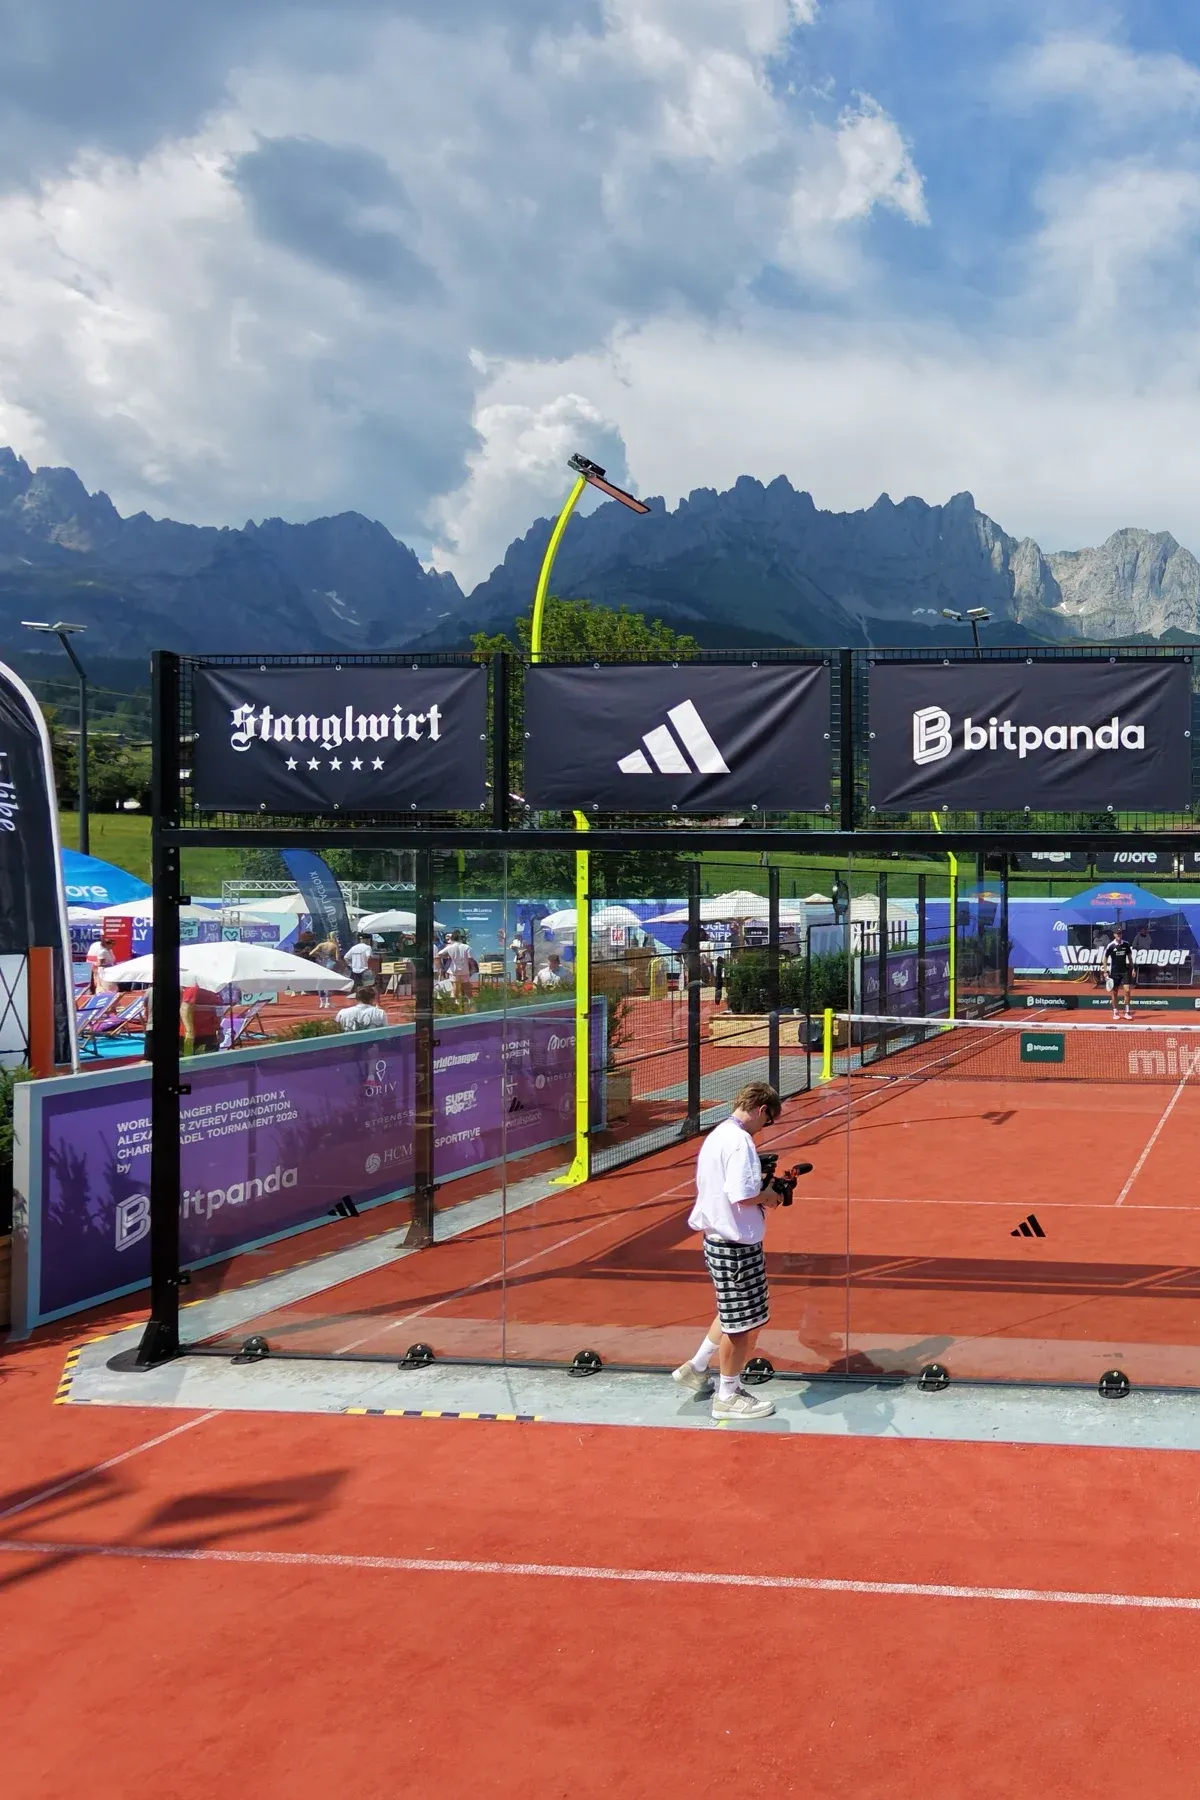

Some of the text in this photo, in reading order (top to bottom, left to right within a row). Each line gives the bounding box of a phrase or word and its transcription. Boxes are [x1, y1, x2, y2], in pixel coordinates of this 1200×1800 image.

[230, 702, 442, 752] Stanglwirt
[964, 716, 1145, 759] bitpanda
[66, 884, 108, 897] ore
[1059, 946, 1190, 966] Worlhanger
[1035, 997, 1066, 1006] bitpanda
[215, 1092, 277, 1113] FOUNDATION
[279, 1089, 286, 1099] X
[188, 1113, 228, 1131] ZVEREV
[230, 1100, 291, 1122] FOUNDATION
[364, 1110, 415, 1128] STRENESS
[207, 1115, 274, 1139] TOURNAMENT
[434, 1127, 480, 1148] SPORTFIVE
[117, 1163, 131, 1174] by
[178, 1165, 298, 1219] itpanda
